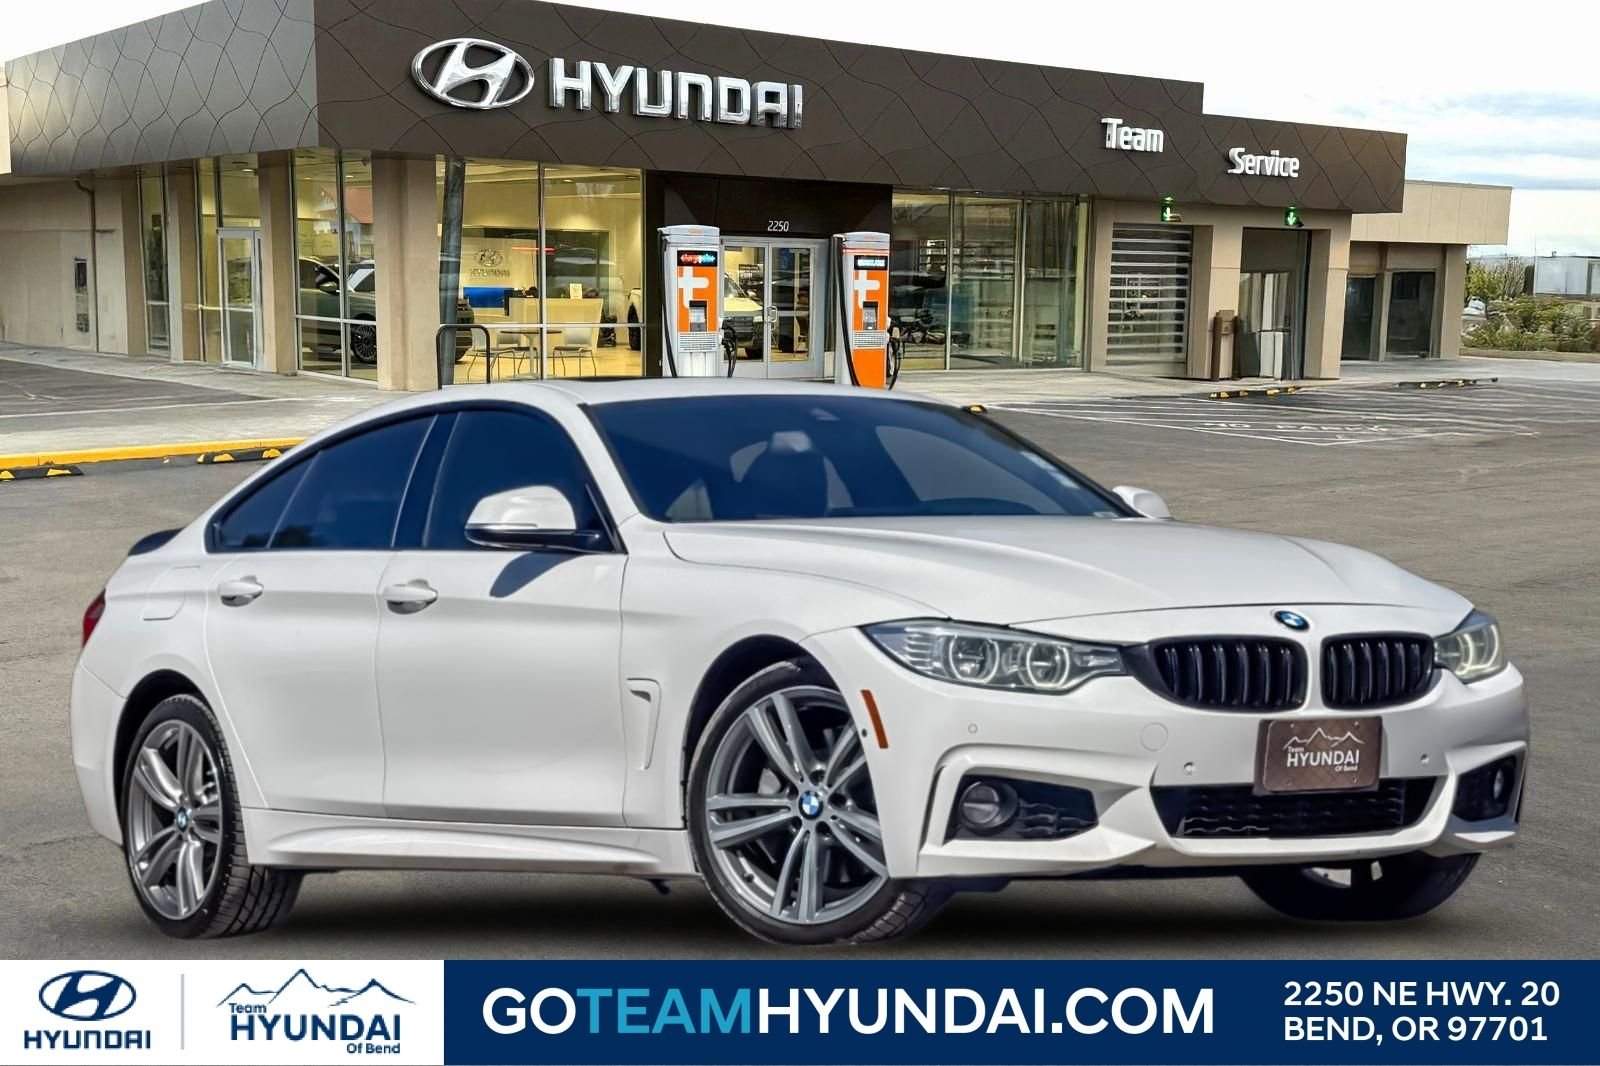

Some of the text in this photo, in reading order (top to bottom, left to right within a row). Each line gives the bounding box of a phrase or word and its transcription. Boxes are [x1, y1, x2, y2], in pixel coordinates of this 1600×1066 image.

[548, 57, 803, 129] HYUNDAI
[1101, 117, 1164, 152] Team
[1227, 147, 1300, 178] Service
[767, 220, 790, 232] 2250
[1286, 749, 1360, 767] HYUNDAI
